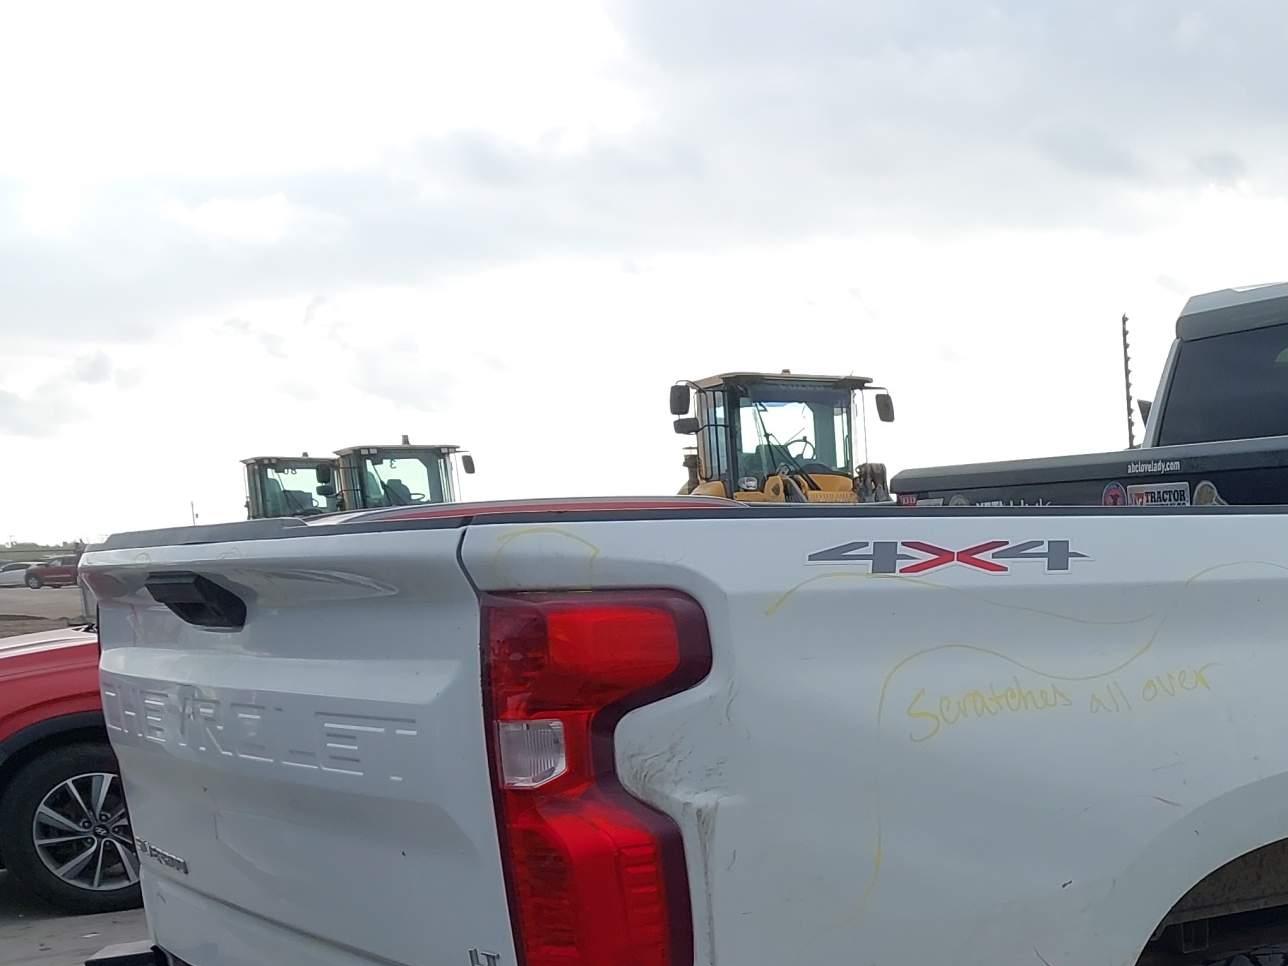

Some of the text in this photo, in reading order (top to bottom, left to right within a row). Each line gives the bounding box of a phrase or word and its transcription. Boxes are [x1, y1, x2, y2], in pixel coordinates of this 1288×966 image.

[1126, 460, 1181, 474] abclovelady.com
[1145, 489, 1186, 502] TRACTOR
[1089, 681, 1133, 715] all
[1142, 661, 1223, 702] over
